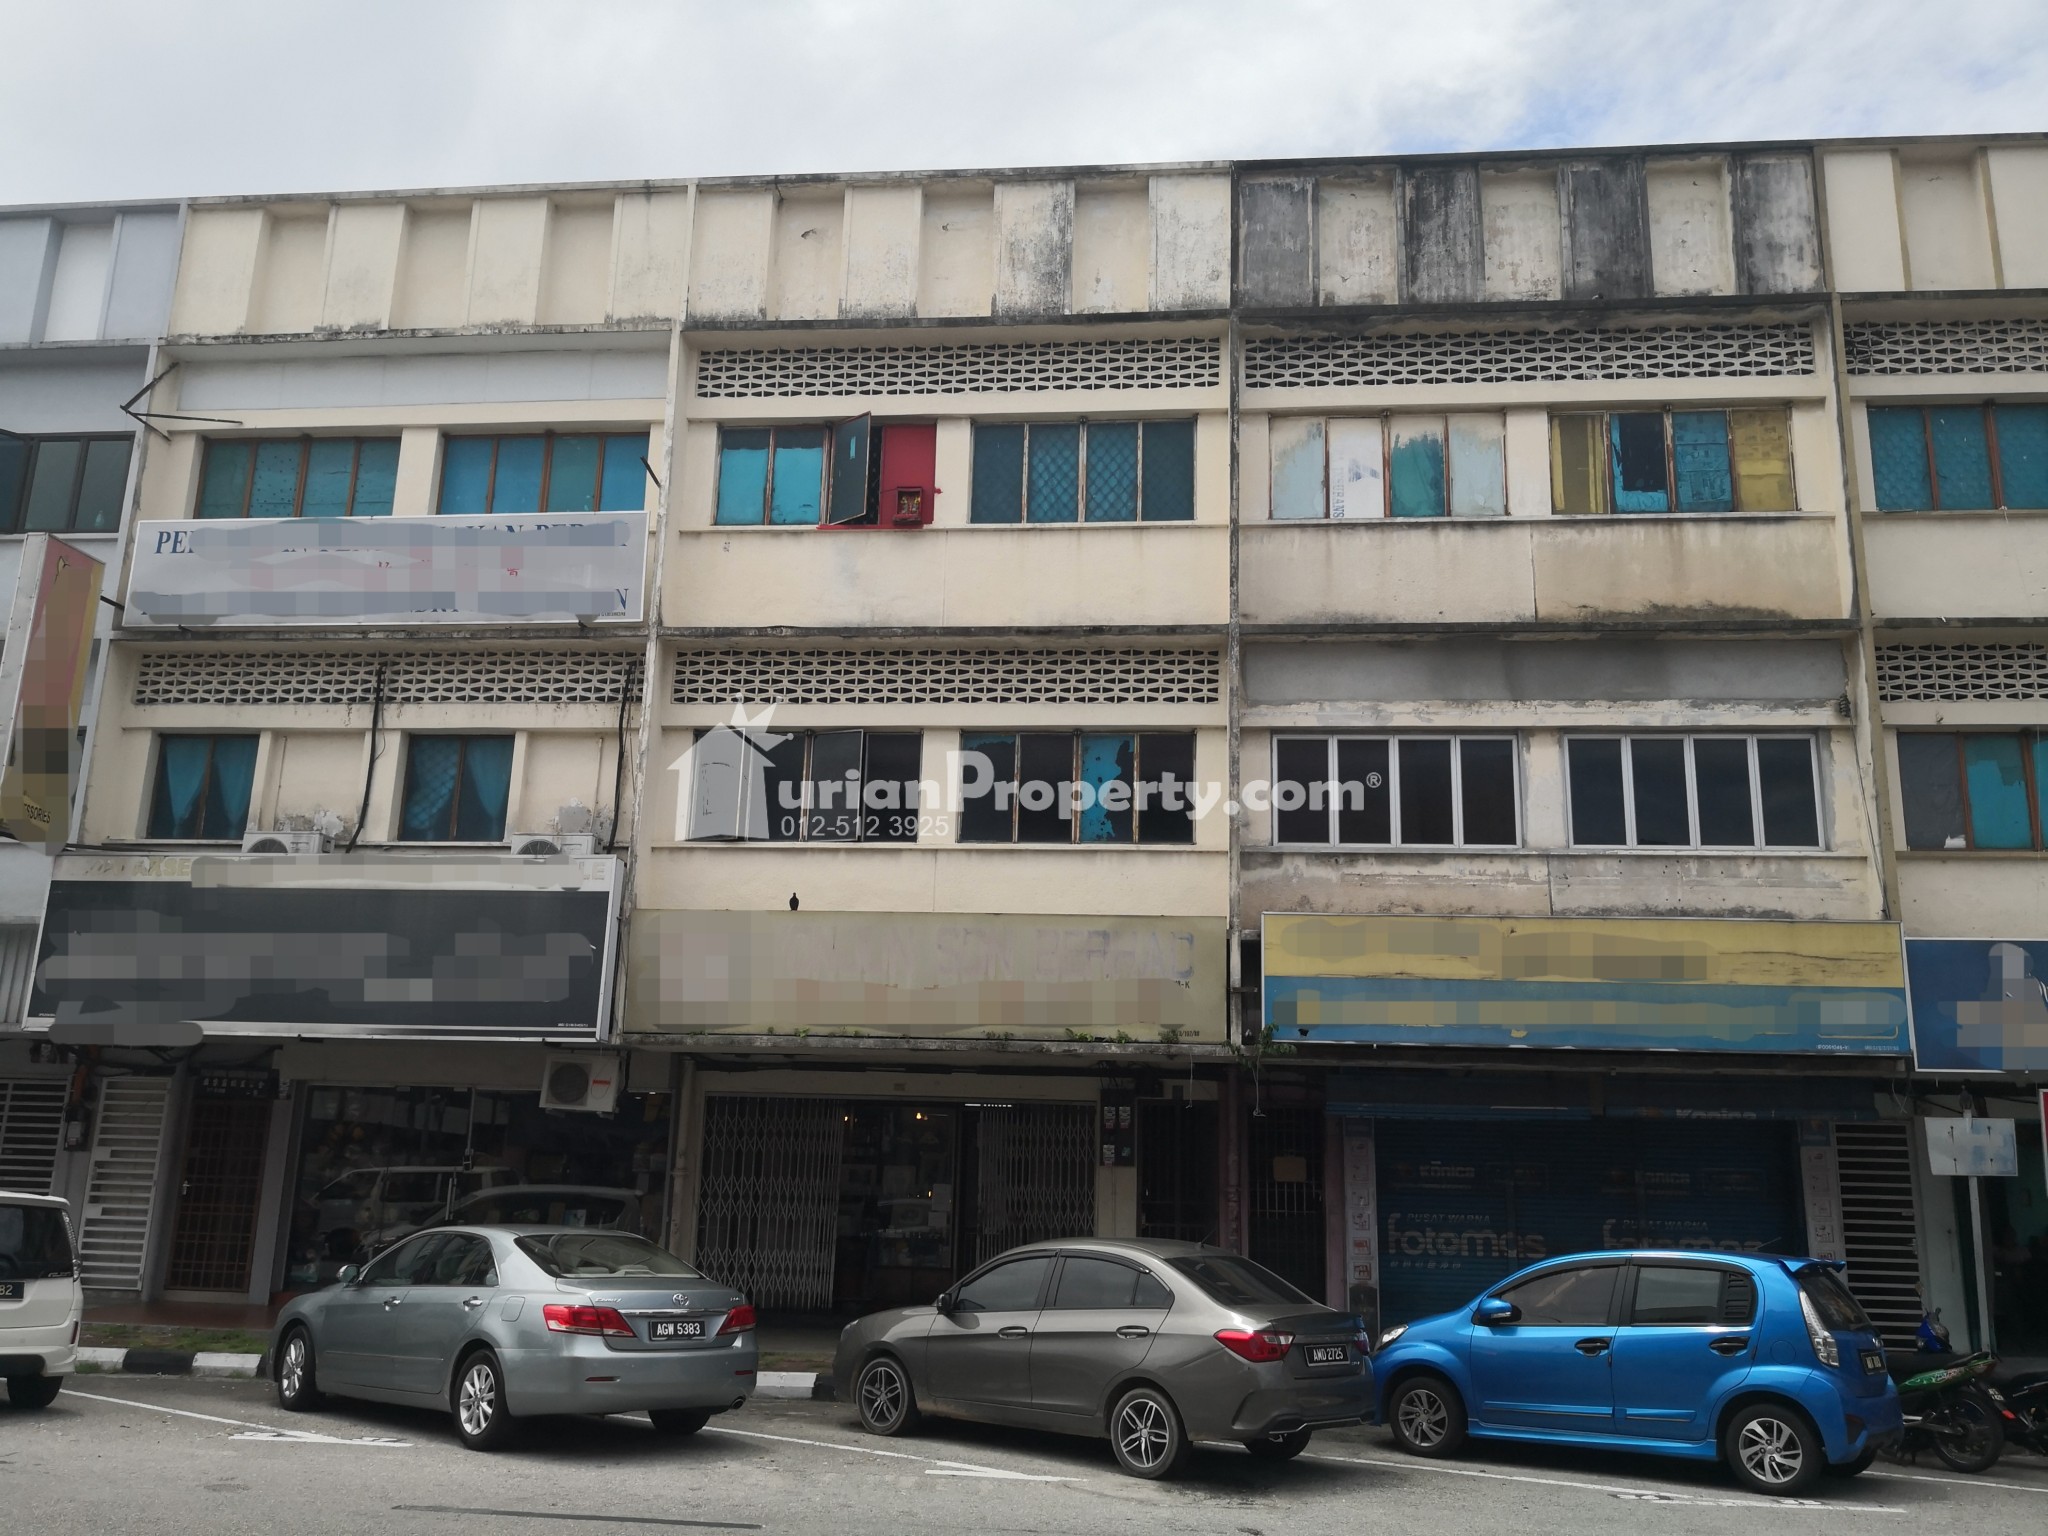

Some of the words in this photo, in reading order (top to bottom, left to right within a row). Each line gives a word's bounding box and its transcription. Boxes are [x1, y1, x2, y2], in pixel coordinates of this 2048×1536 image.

[1387, 1212, 1547, 1258] fotomas
[656, 1323, 675, 1336] AGW
[677, 1323, 700, 1335] 5383
[1327, 1348, 1344, 1360] 2725
